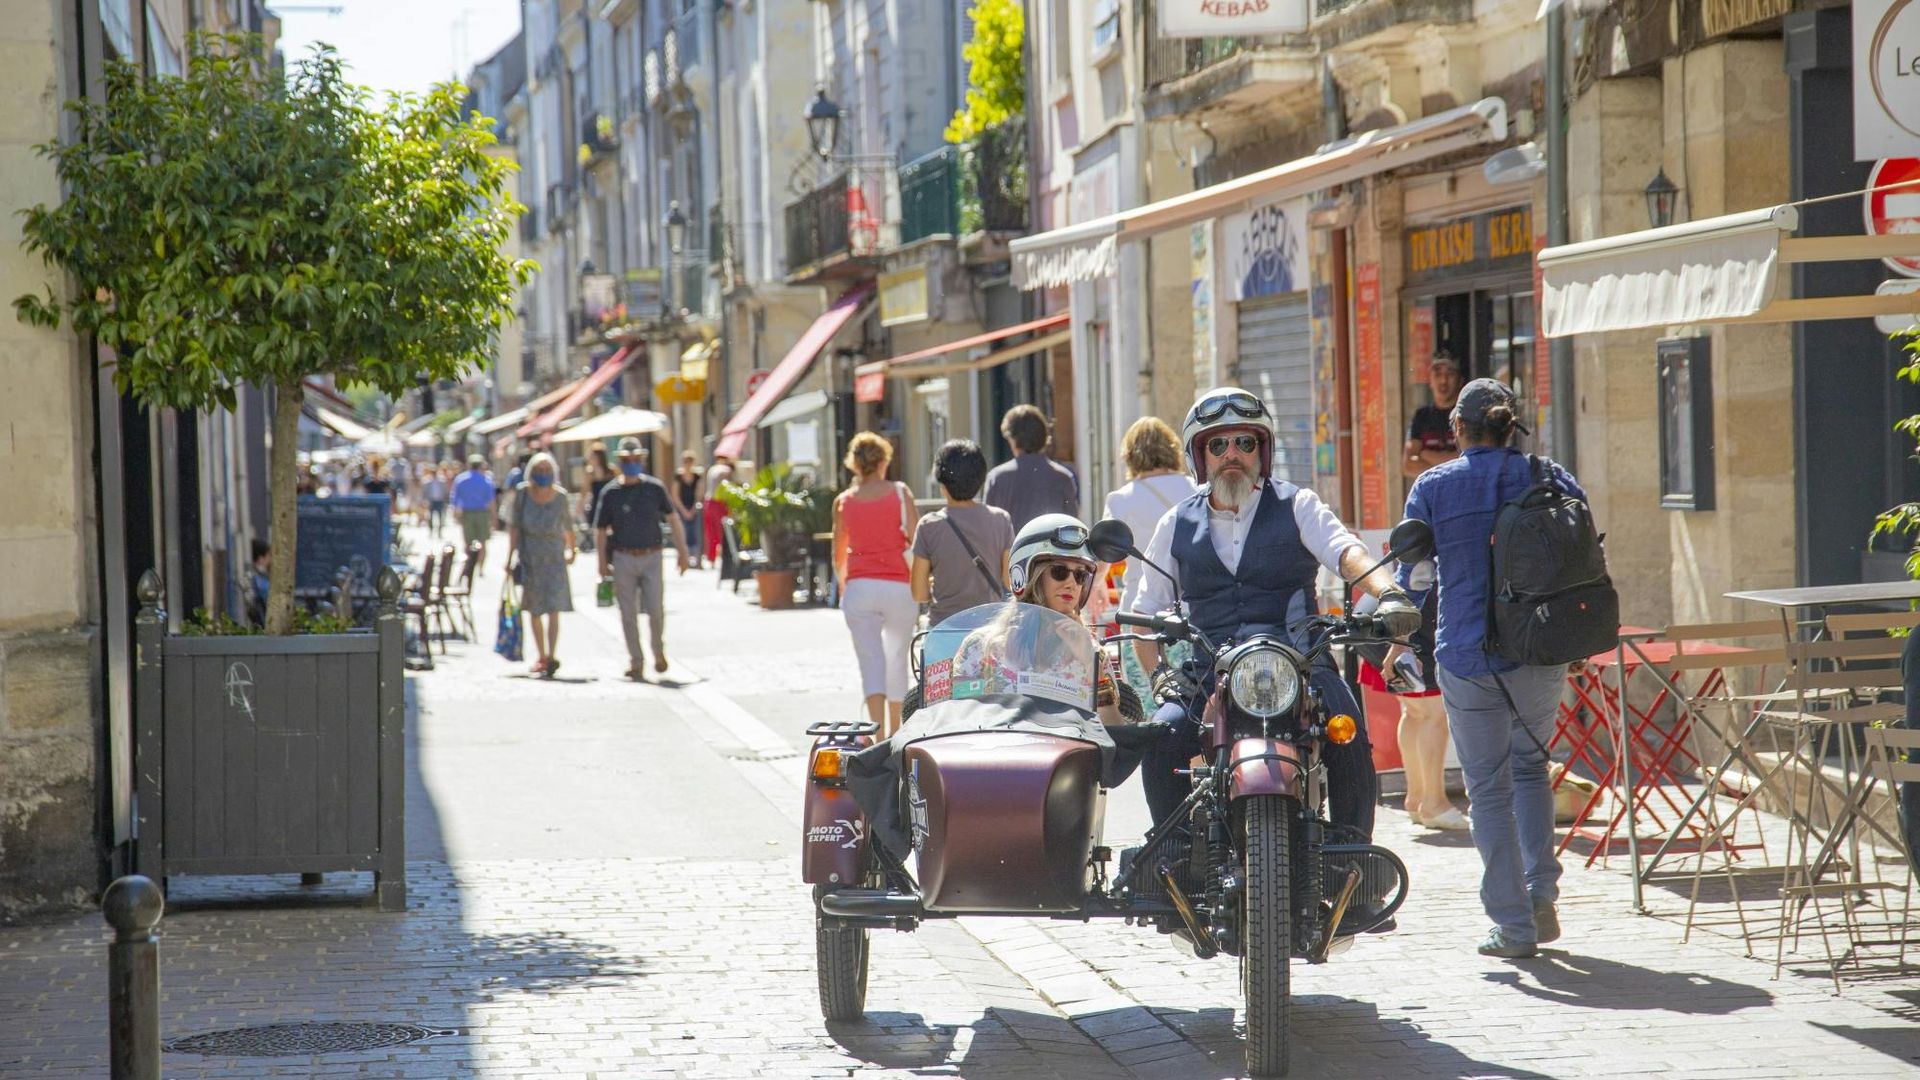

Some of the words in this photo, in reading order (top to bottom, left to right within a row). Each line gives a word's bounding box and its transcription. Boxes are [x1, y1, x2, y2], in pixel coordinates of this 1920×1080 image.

[1201, 0, 1269, 17] KEBAB
[1411, 221, 1474, 272] TURKISH
[927, 661, 951, 677] 2020
[808, 834, 845, 842] EXPERT
[809, 826, 843, 835] MOTO
